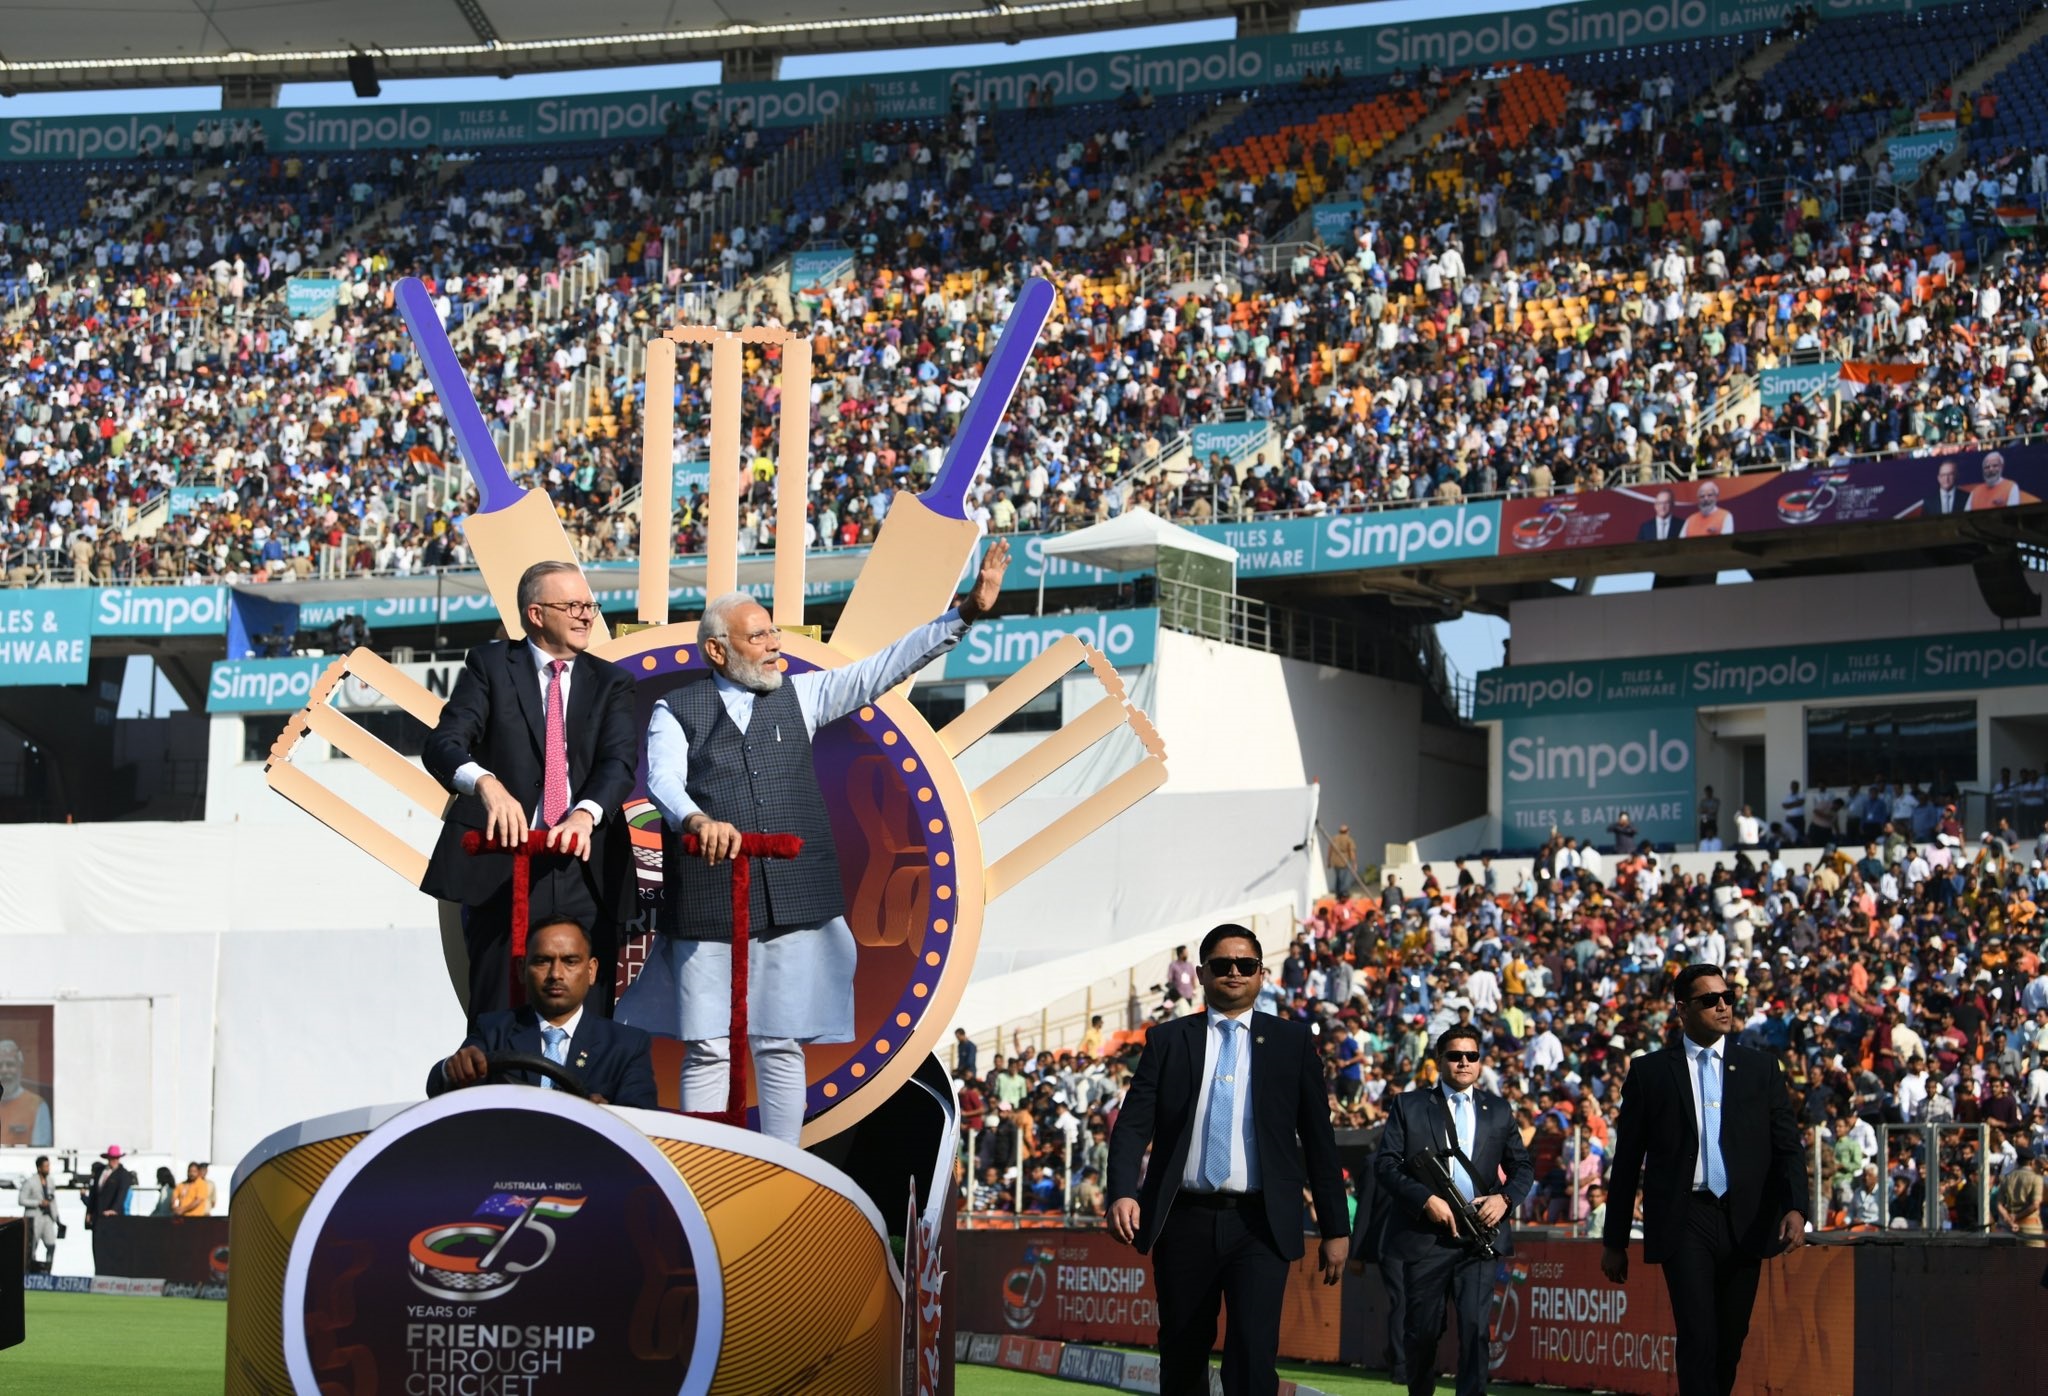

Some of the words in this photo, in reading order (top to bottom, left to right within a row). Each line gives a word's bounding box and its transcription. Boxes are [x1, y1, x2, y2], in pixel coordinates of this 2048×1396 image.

[1546, 0, 1706, 46] Simpolo
[1291, 40, 1329, 57] TILES
[1334, 39, 1345, 53] &
[1376, 16, 1538, 66] Simpolo
[1108, 45, 1262, 92] Simpolo
[909, 80, 920, 94] &
[284, 109, 432, 150] Simpolo
[458, 109, 495, 125] TILES
[498, 109, 509, 122] &
[10, 116, 163, 160] Simpolo
[442, 124, 525, 142] BATHWARE
[1225, 529, 1267, 548] TILES
[1273, 529, 1284, 546] &
[1326, 507, 1492, 562] Simpolo
[1240, 549, 1304, 570] HWARE
[42, 610, 58, 633] &
[1847, 655, 1880, 668] TILES
[1883, 654, 1893, 666] &
[211, 662, 320, 704] Simpol
[1621, 671, 1651, 683] TILES
[1654, 669, 1664, 681] &
[1693, 656, 1817, 694] Simpolo
[1832, 668, 1907, 684] BATHWARE
[1478, 671, 1594, 709] Simpolo
[1607, 682, 1677, 699] BATHWARE
[1507, 729, 1690, 789] Simpolo
[1515, 809, 1557, 828] TILES
[1563, 808, 1575, 825] &
[493, 1181, 547, 1191] AUSTRALIA
[554, 1182, 582, 1191] INDIA
[1057, 1265, 1145, 1293] FRIENDSHIP
[1531, 1263, 1552, 1278] YEARS
[1553, 1264, 1564, 1279] OF
[55, 1277, 91, 1292] ASTRAL
[407, 1305, 453, 1318] YEARS
[457, 1306, 477, 1318] OF
[1056, 1295, 1128, 1324] THROUGH
[1531, 1286, 1627, 1324] FRIENDSHIP
[406, 1323, 595, 1350] FRIENDSHIP
[1530, 1326, 1608, 1365] THROUGH
[407, 1349, 562, 1374] THROUGH
[1060, 1347, 1088, 1378] ASTRAL
[1089, 1351, 1122, 1384] ASTRAL
[405, 1373, 539, 1396] CRICKET
